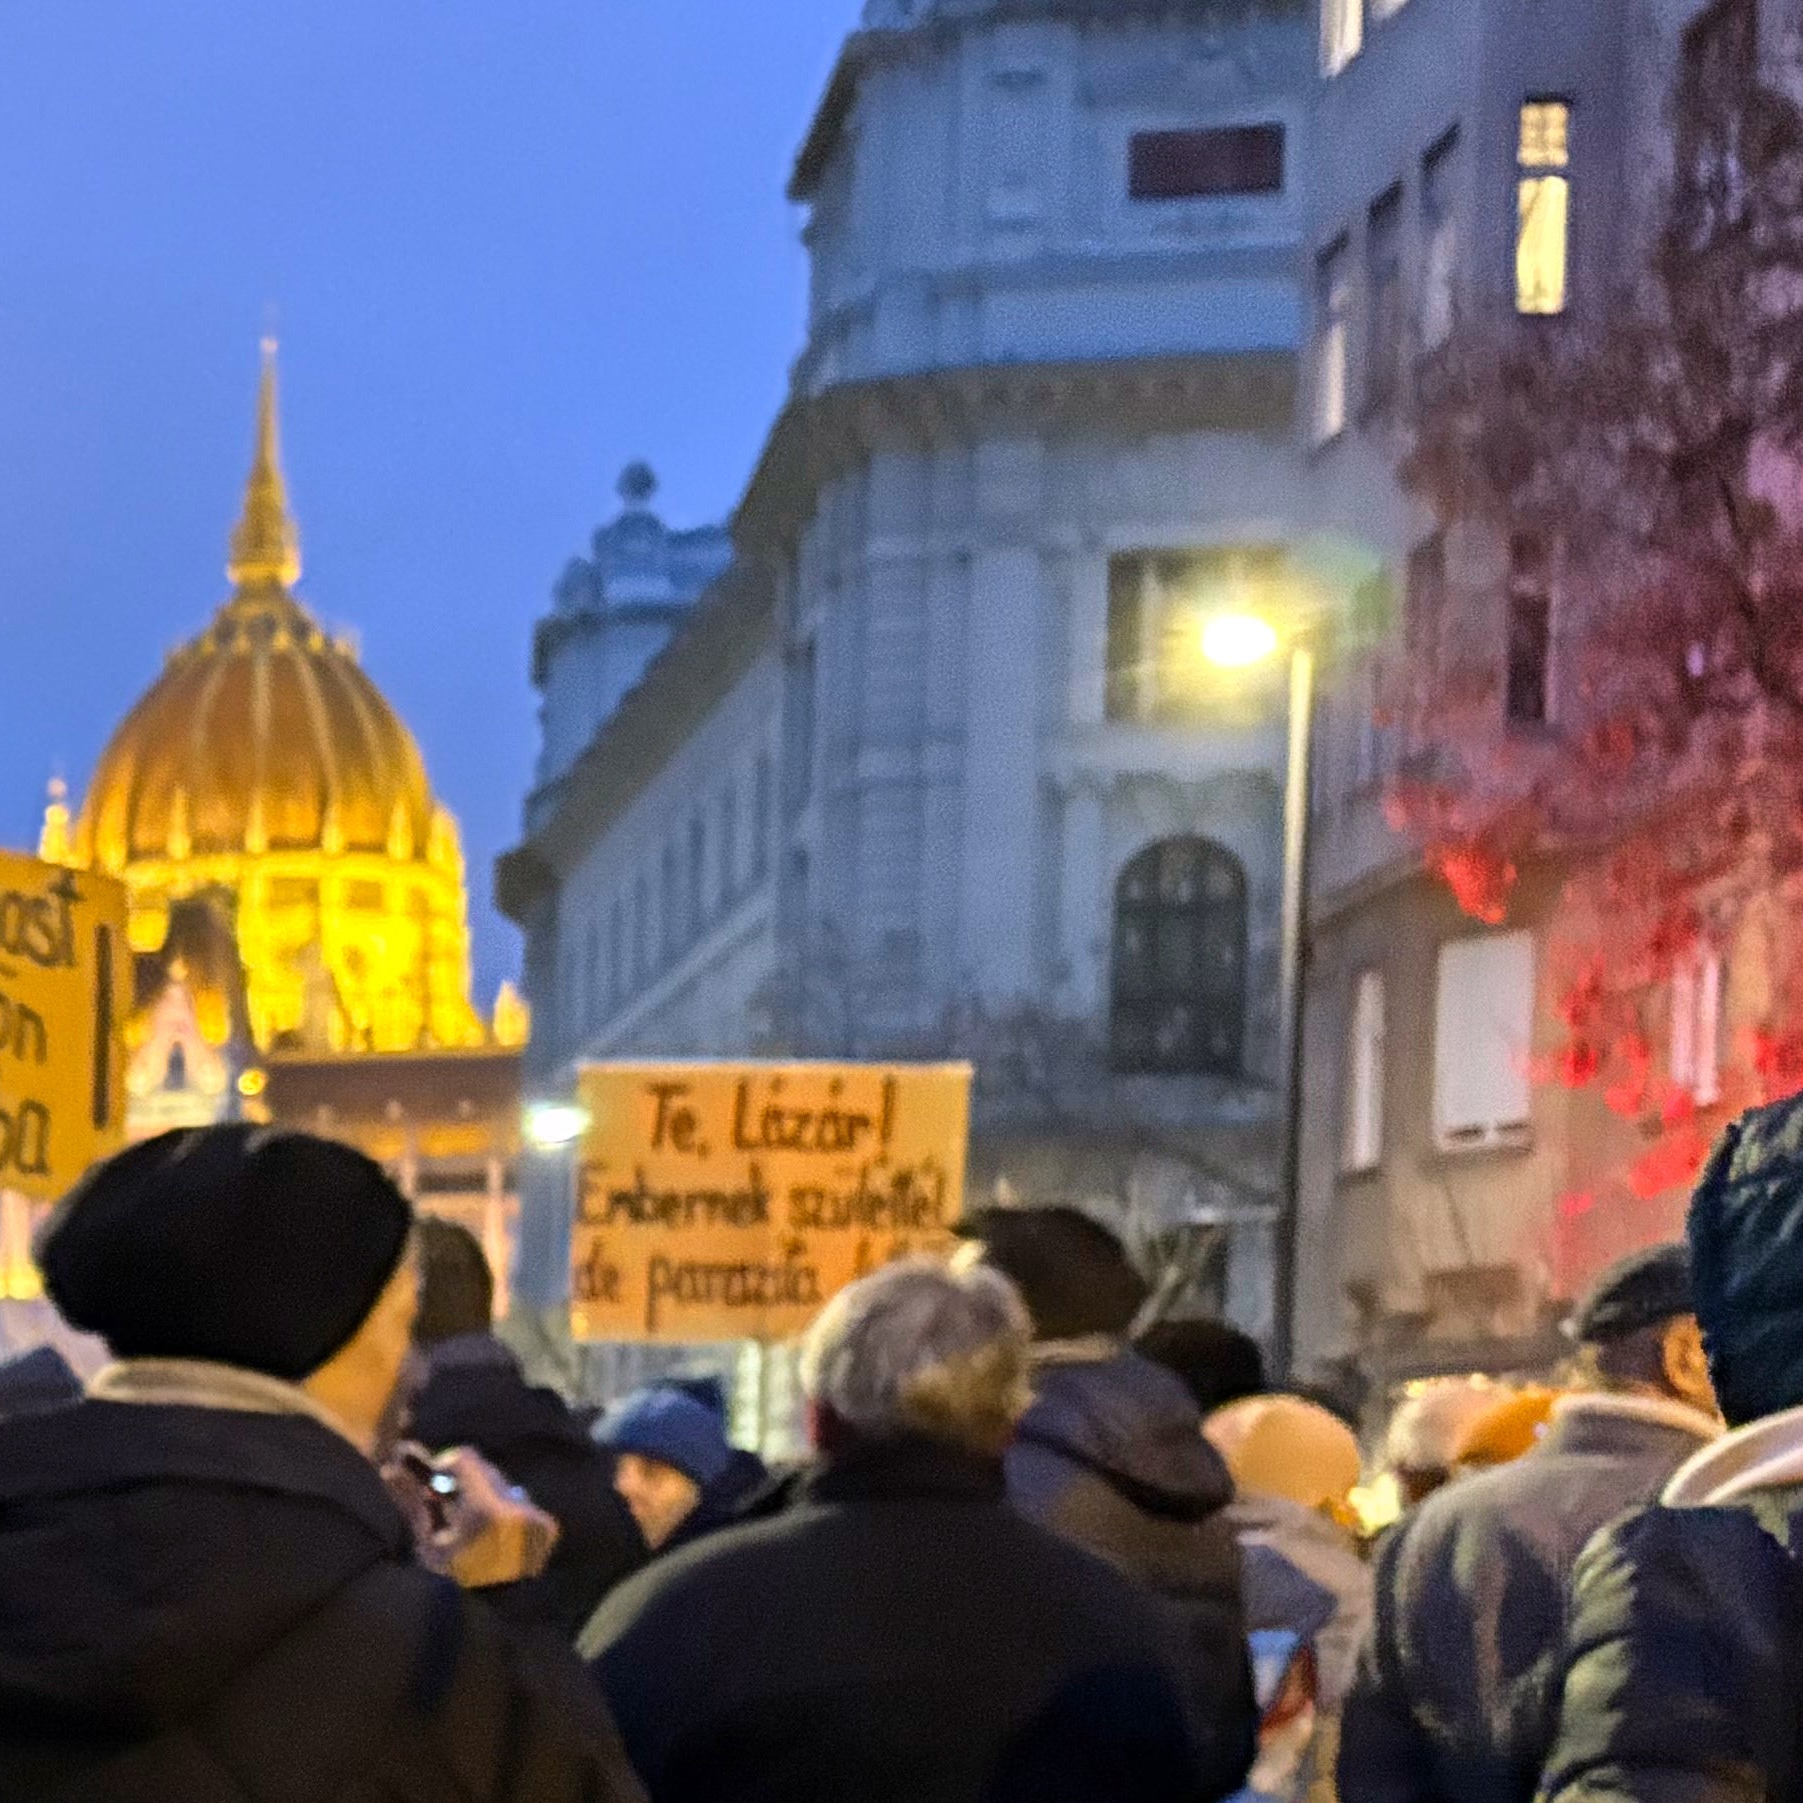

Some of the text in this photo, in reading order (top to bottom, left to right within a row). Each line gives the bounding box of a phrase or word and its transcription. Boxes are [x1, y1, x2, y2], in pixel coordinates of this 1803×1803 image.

[732, 1073, 898, 1166] Lázár!
[573, 1237, 620, 1304] de
[646, 1238, 824, 1332] parazita
